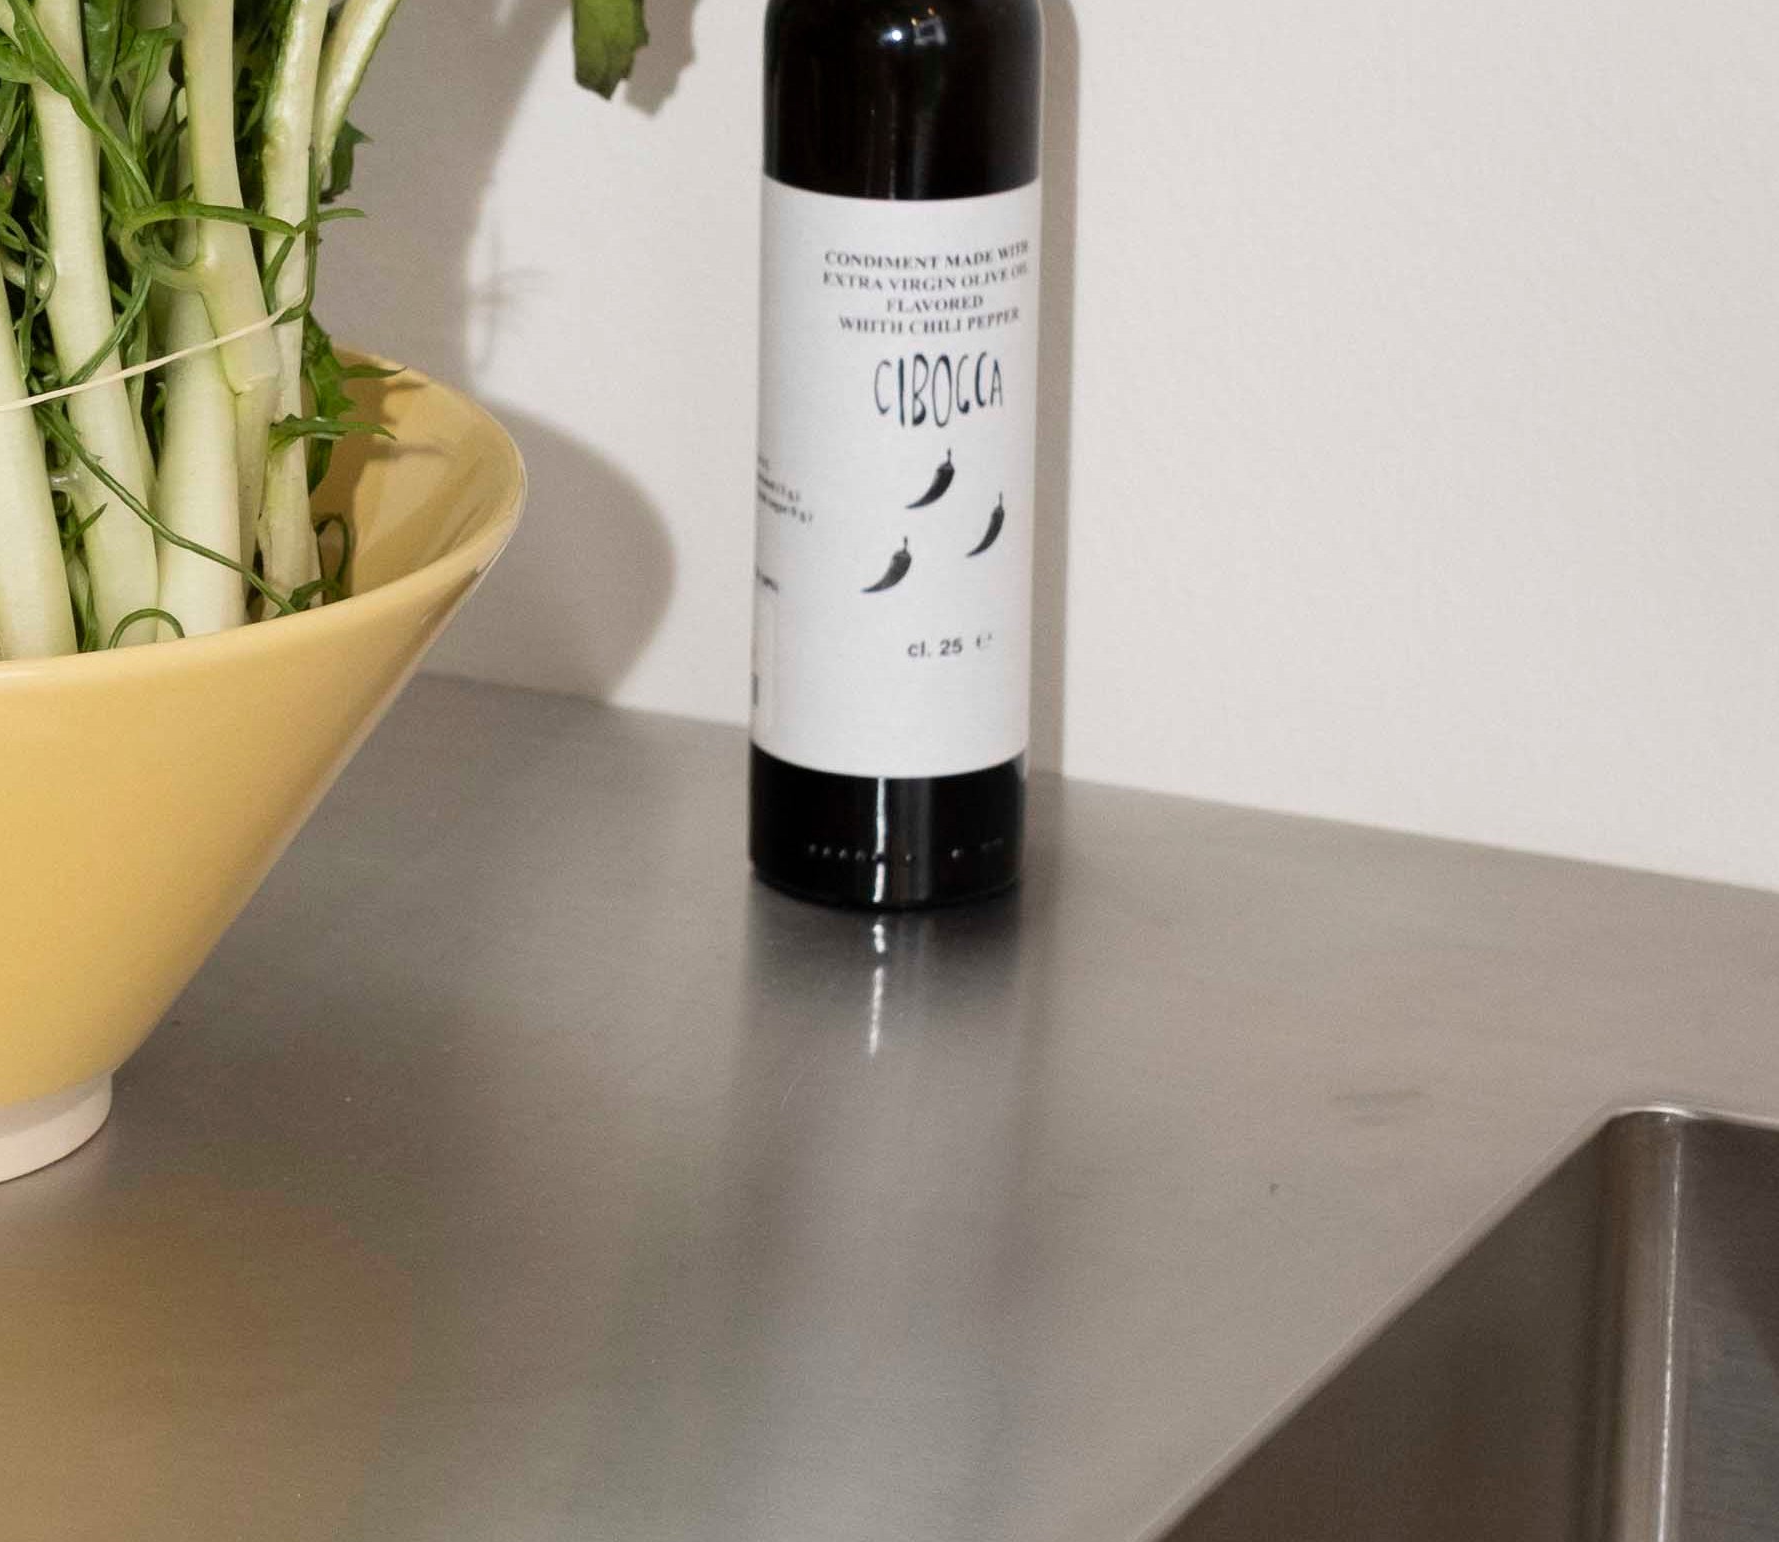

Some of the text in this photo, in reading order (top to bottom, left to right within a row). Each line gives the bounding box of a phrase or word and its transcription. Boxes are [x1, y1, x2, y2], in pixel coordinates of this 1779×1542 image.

[824, 250, 938, 269] CONDIMENT
[944, 252, 992, 267] MADE
[823, 271, 883, 290] EXTRA
[888, 276, 955, 291] VIRGIN
[961, 268, 1007, 288] OLIVE
[886, 295, 984, 313] FLAVORED
[908, 319, 962, 334] CHILI
[967, 306, 1019, 331] PEPPER
[874, 351, 1003, 427] CIBOCCA
[939, 637, 963, 657] 25
